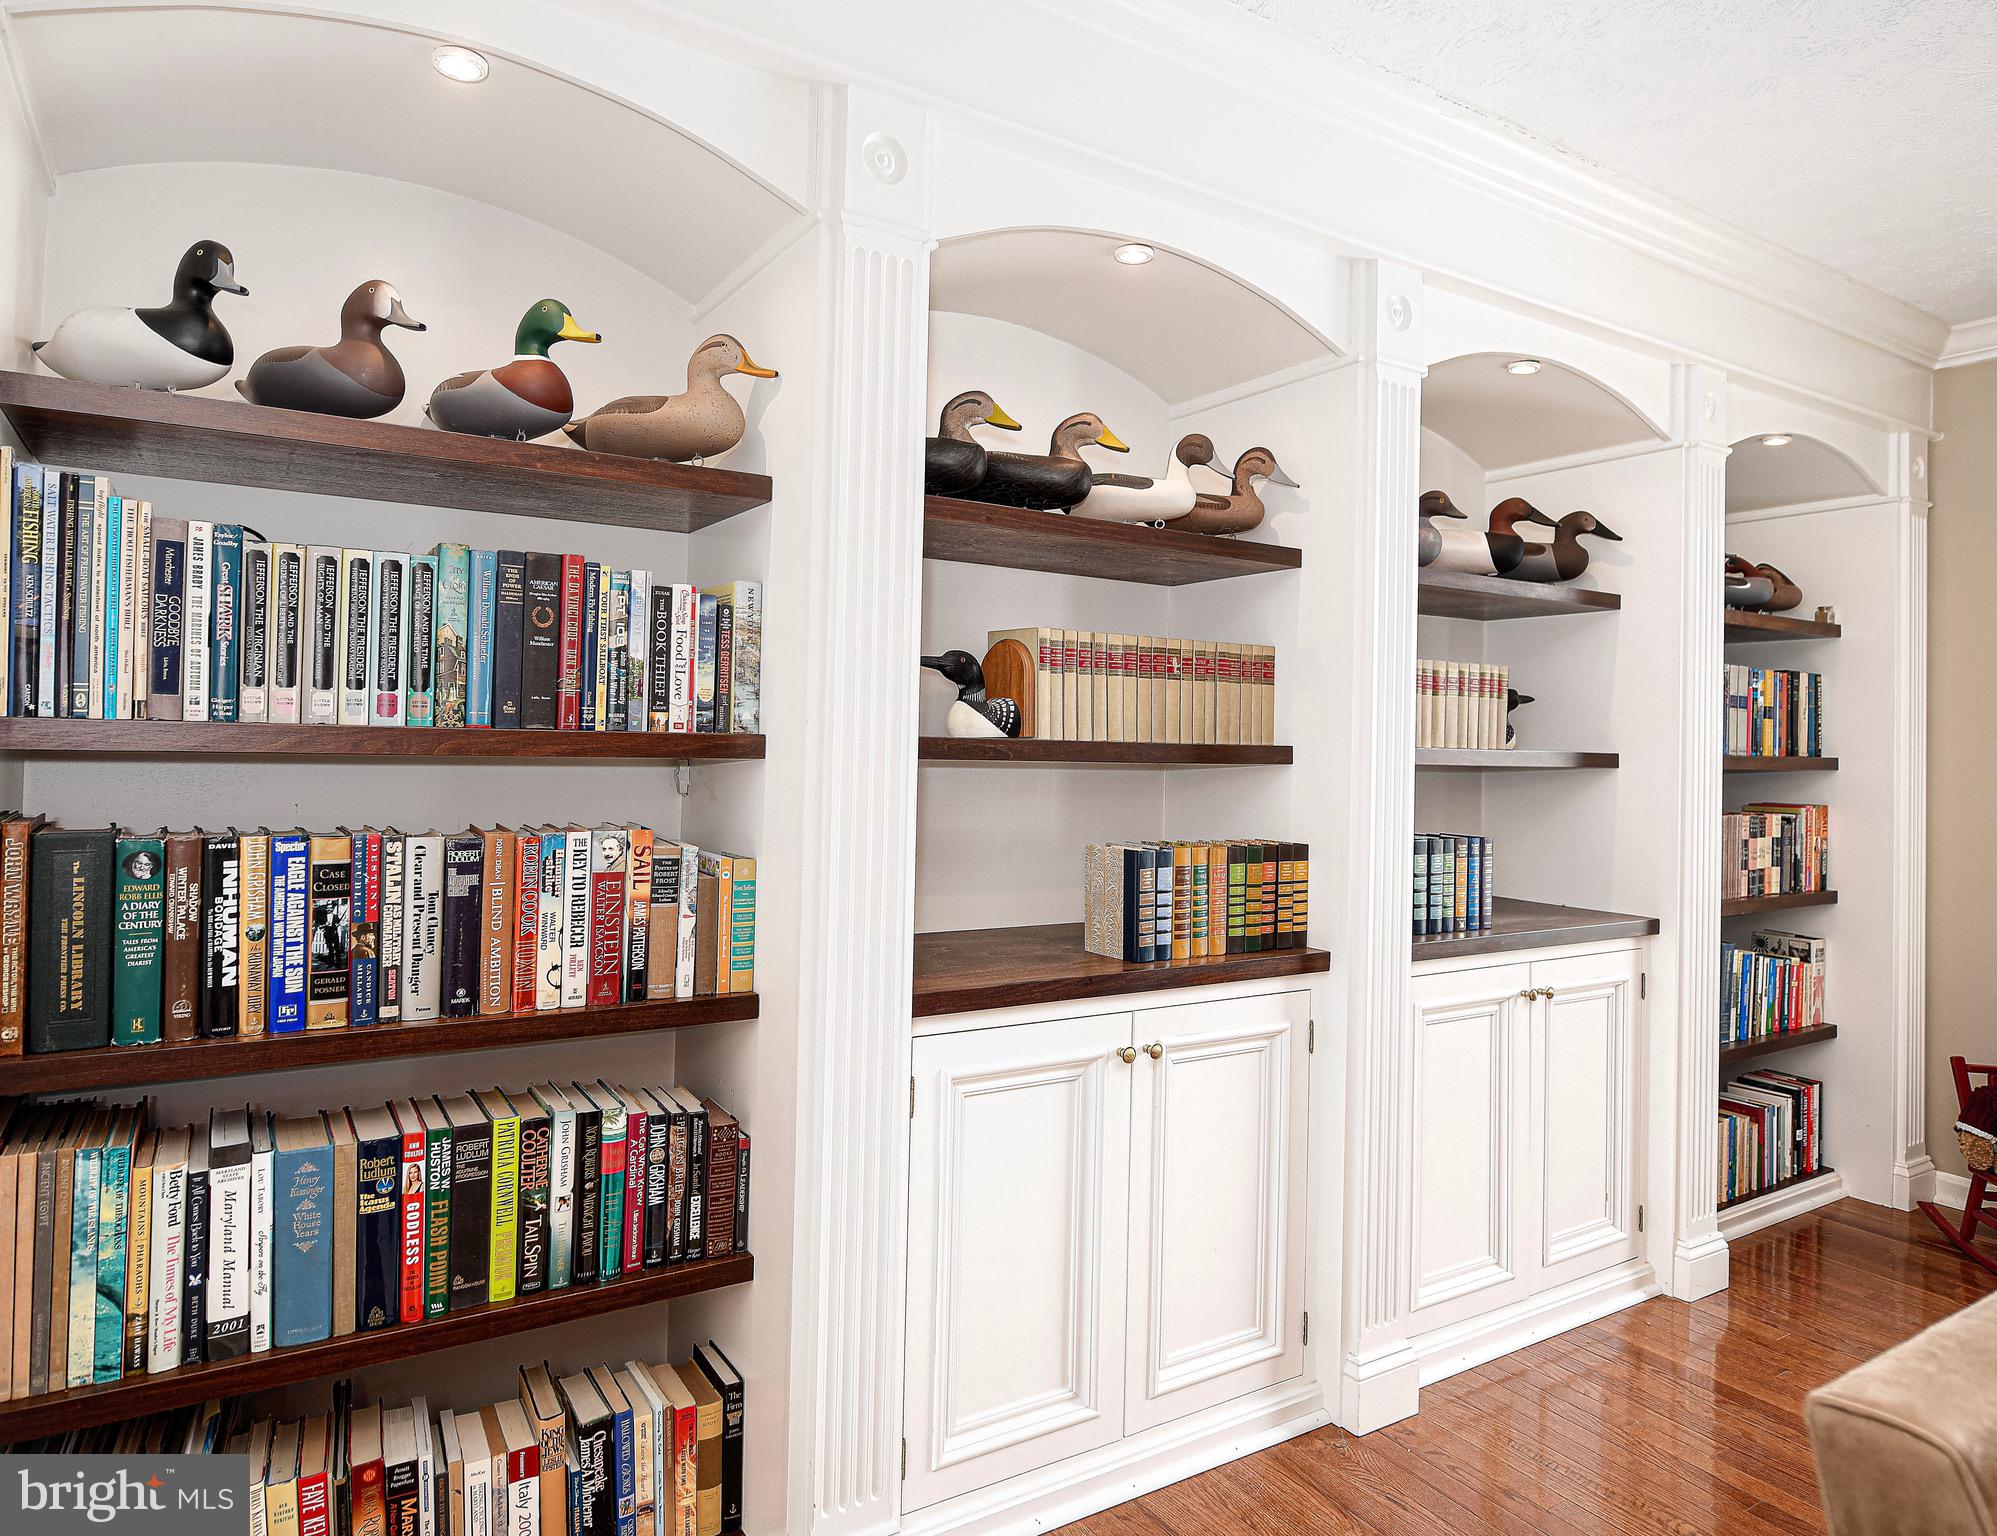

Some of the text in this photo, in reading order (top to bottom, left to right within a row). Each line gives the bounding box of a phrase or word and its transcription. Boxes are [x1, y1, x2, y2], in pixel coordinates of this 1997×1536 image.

[31, 489, 39, 508] NORTH
[47, 484, 56, 506] SALT
[21, 511, 39, 564] FISHING
[46, 510, 56, 544] WATER
[44, 547, 55, 589] FISHING
[79, 514, 89, 633] THE ART OF FRESHWATER FISHING
[164, 548, 174, 585] Manchester
[192, 537, 203, 589] JAMES BRADY
[326, 565, 334, 608] JEFFERSON
[24, 575, 34, 617] KEN SCHULTZ
[44, 592, 54, 634] TACTICS
[154, 593, 168, 647] DARKNESS
[217, 562, 233, 666] Great SHARK Stories
[254, 560, 265, 677] JEFFERSON THE VIRGINIAN
[317, 592, 323, 601] OF
[480, 570, 491, 663] William Donald Schaefer
[567, 565, 579, 641] THE DA VINCI CODE
[656, 611, 666, 650] BOOK
[566, 650, 577, 696] DAN BROWN
[656, 654, 666, 696] THIEF
[720, 630, 730, 693] TESS GERRITSEN
[3, 839, 23, 945] JOHN WAYNE
[247, 840, 265, 921] JOHN GRISHAM
[354, 841, 362, 917] REPUBLIC
[370, 844, 378, 910] DESTINY
[386, 842, 402, 904] STALIN
[570, 838, 587, 948] THE KEY TO REBECCA
[633, 845, 651, 890] SAIL
[71, 877, 84, 939] LINCOLN
[119, 921, 162, 930] CENTURY
[130, 901, 160, 910] DIARY
[137, 911, 159, 919] THE
[214, 896, 223, 952] BONDAGE
[222, 860, 238, 987] INHUMAN
[285, 858, 305, 993] EAGLE AGAINST THE SUN
[407, 846, 426, 995] Clear and Present Danger
[425, 890, 439, 955] Tom Clancy
[594, 881, 605, 976] WALTER ISAACSON
[603, 881, 621, 974] EINSTEIN
[382, 905, 393, 967] COMMANDER
[392, 905, 401, 966] AS MILITARY
[490, 888, 502, 1006] BLIND AMBITION
[631, 900, 647, 970] JAMES PATTERSON
[71, 944, 84, 1010] LIBRARY
[247, 953, 262, 1014] RUNAWAY JURY
[388, 969, 396, 999] SEATON
[360, 1156, 394, 1169] Robert
[360, 1167, 397, 1181] Ludlum
[430, 1143, 440, 1190] HUSTON
[440, 1137, 450, 1192] JAMES W.
[496, 1122, 515, 1226] PATRICIA CORNWELL
[521, 1131, 535, 1191] COULTER
[536, 1128, 549, 1190] CATHERINE
[675, 1122, 685, 1194] PELICAN BRIEF
[167, 1171, 183, 1228] Betty Ford
[690, 1196, 701, 1240] EXCELLENCE
[136, 1180, 146, 1294] MOUNTAINS PHARAOHS
[221, 1190, 237, 1309] Maryland Manual
[406, 1203, 420, 1265] GODLESS
[430, 1200, 448, 1294] FLASH POINT
[673, 1218, 681, 1246] GRISHAM
[162, 1233, 180, 1352] The Times of My Life
[190, 1296, 199, 1339] BETH DUKE
[213, 1323, 244, 1335] 2001
[579, 1436, 594, 1468] James
[593, 1431, 608, 1492] Chesapeake
[621, 1419, 631, 1460] HALLOWED
[302, 1482, 324, 1512] FAYE
[516, 1481, 531, 1509] Italy
[582, 1480, 594, 1528] Michener
